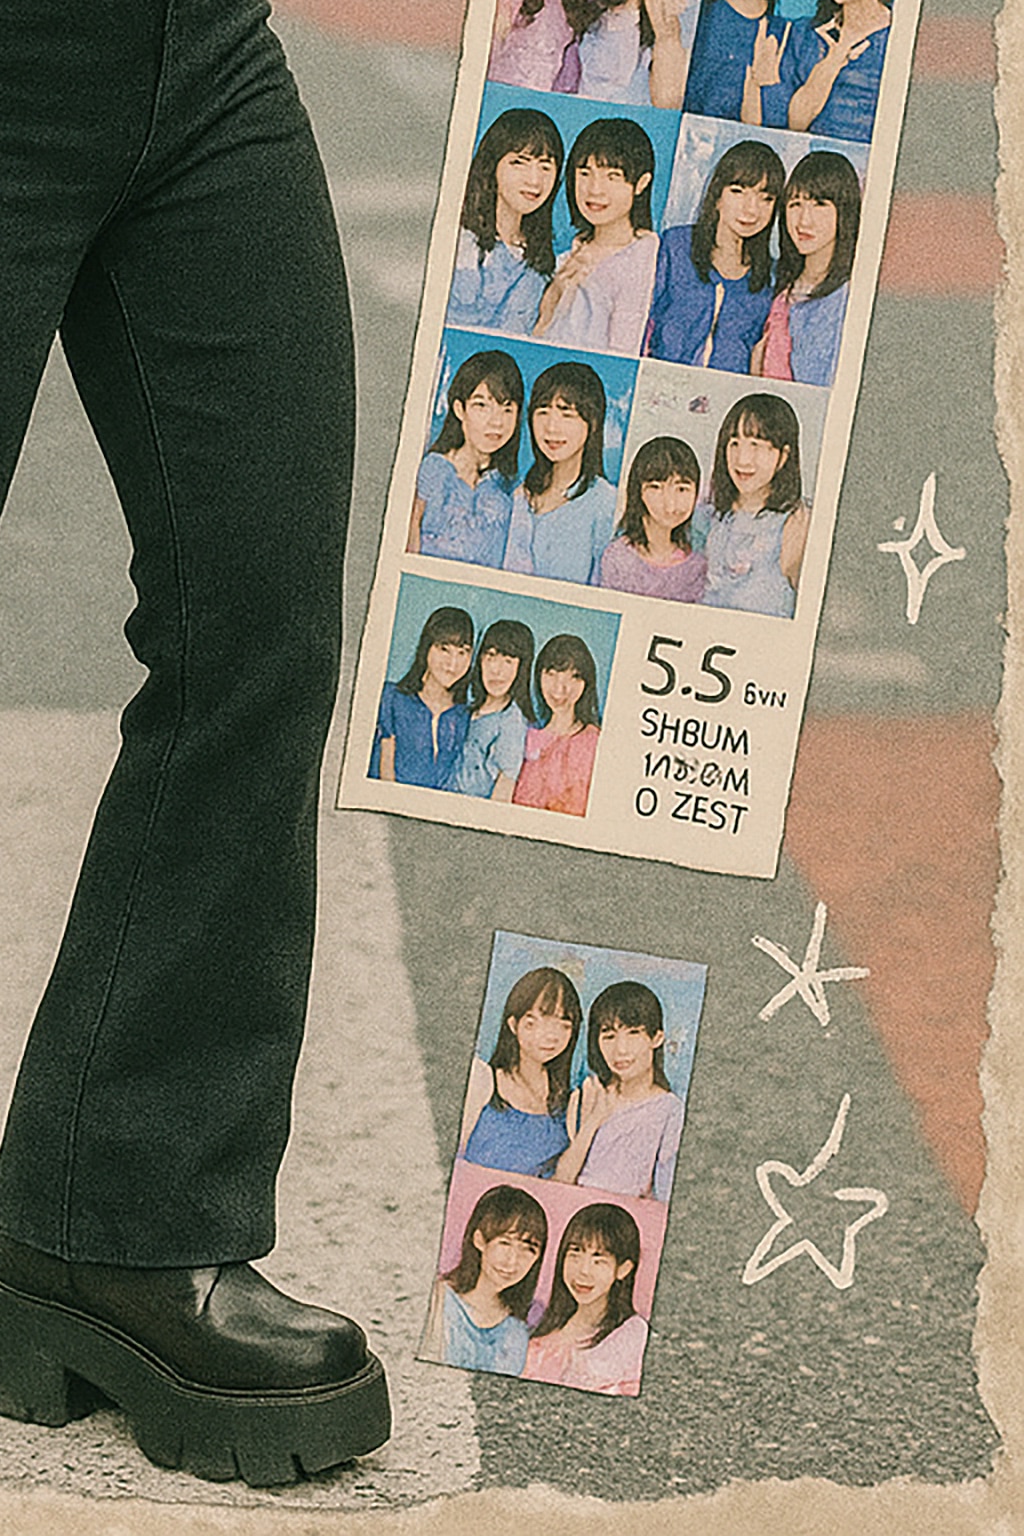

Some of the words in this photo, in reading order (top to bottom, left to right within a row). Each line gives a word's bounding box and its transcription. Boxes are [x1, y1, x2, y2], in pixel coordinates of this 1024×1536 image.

[640, 635, 737, 703] 5.5
[641, 707, 749, 756] SHBUM
[671, 791, 749, 834] ZEST
